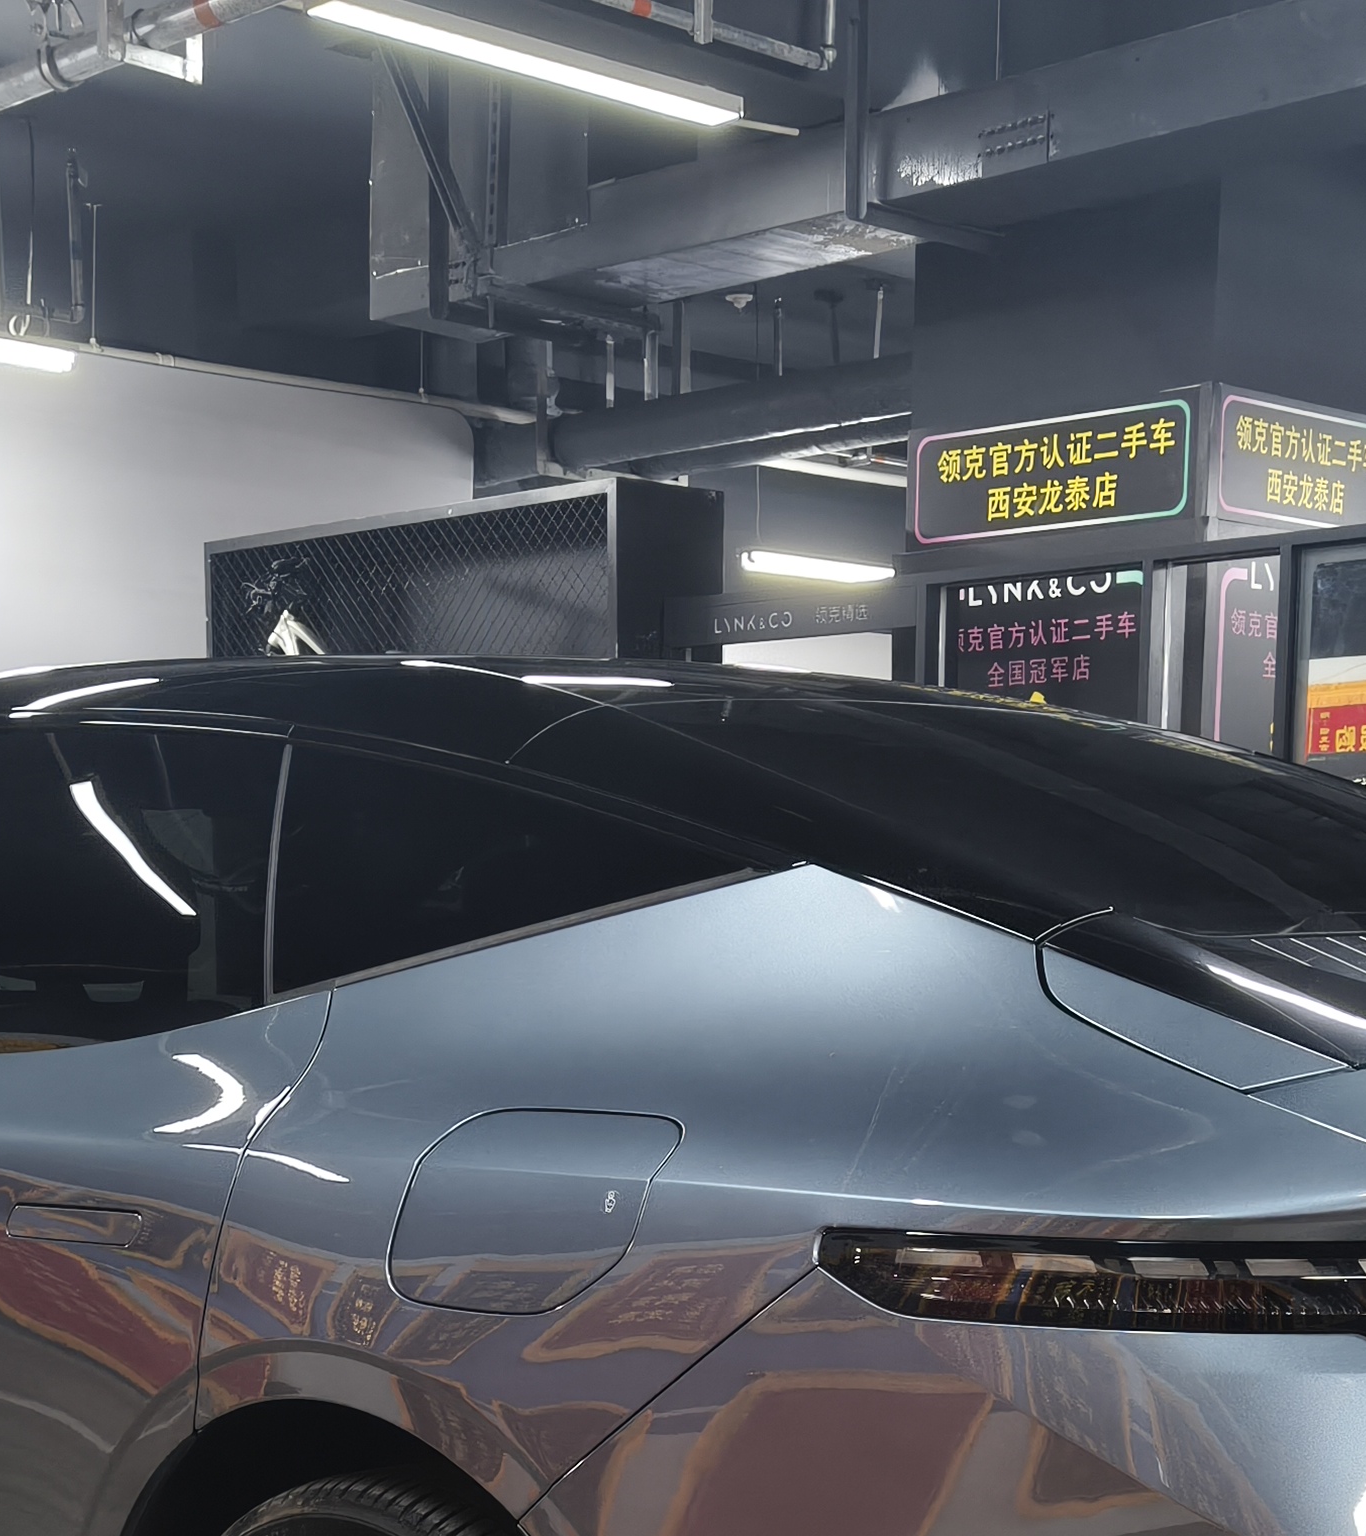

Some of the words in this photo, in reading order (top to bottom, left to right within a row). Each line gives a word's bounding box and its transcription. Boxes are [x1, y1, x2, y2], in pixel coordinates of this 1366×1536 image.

[936, 417, 1176, 484] 领克官方认证二手车
[986, 472, 1118, 522] 西安龙泰店
[1266, 468, 1346, 515] 西安龙泰店
[987, 654, 1091, 688] 全国冠军店
